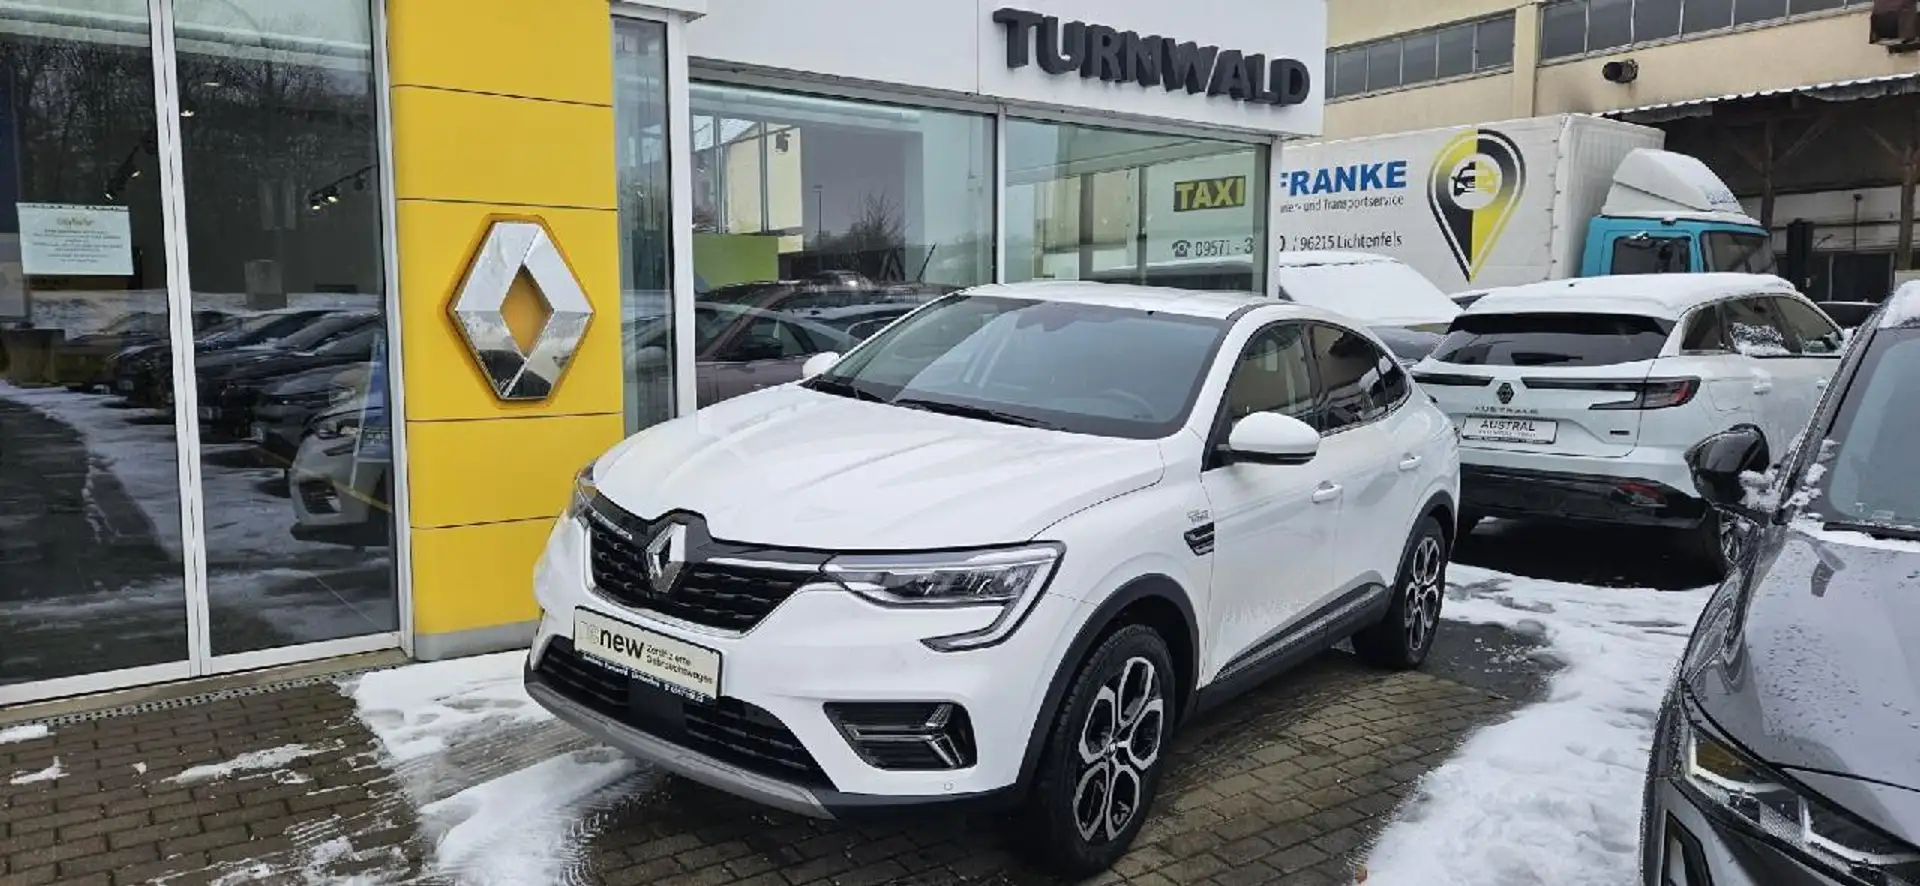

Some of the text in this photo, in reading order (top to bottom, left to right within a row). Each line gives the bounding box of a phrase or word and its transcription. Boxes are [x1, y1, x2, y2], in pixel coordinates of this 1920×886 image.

[993, 8, 1310, 106] TURNWALD
[1176, 178, 1244, 210] TAXI
[1304, 199, 1320, 212] und
[1324, 195, 1404, 210] Transportservice
[1195, 240, 1231, 257] 09571
[1300, 234, 1335, 251] 96215
[1337, 230, 1403, 249] Lichtenfels
[1480, 420, 1535, 432] AUSTRAL
